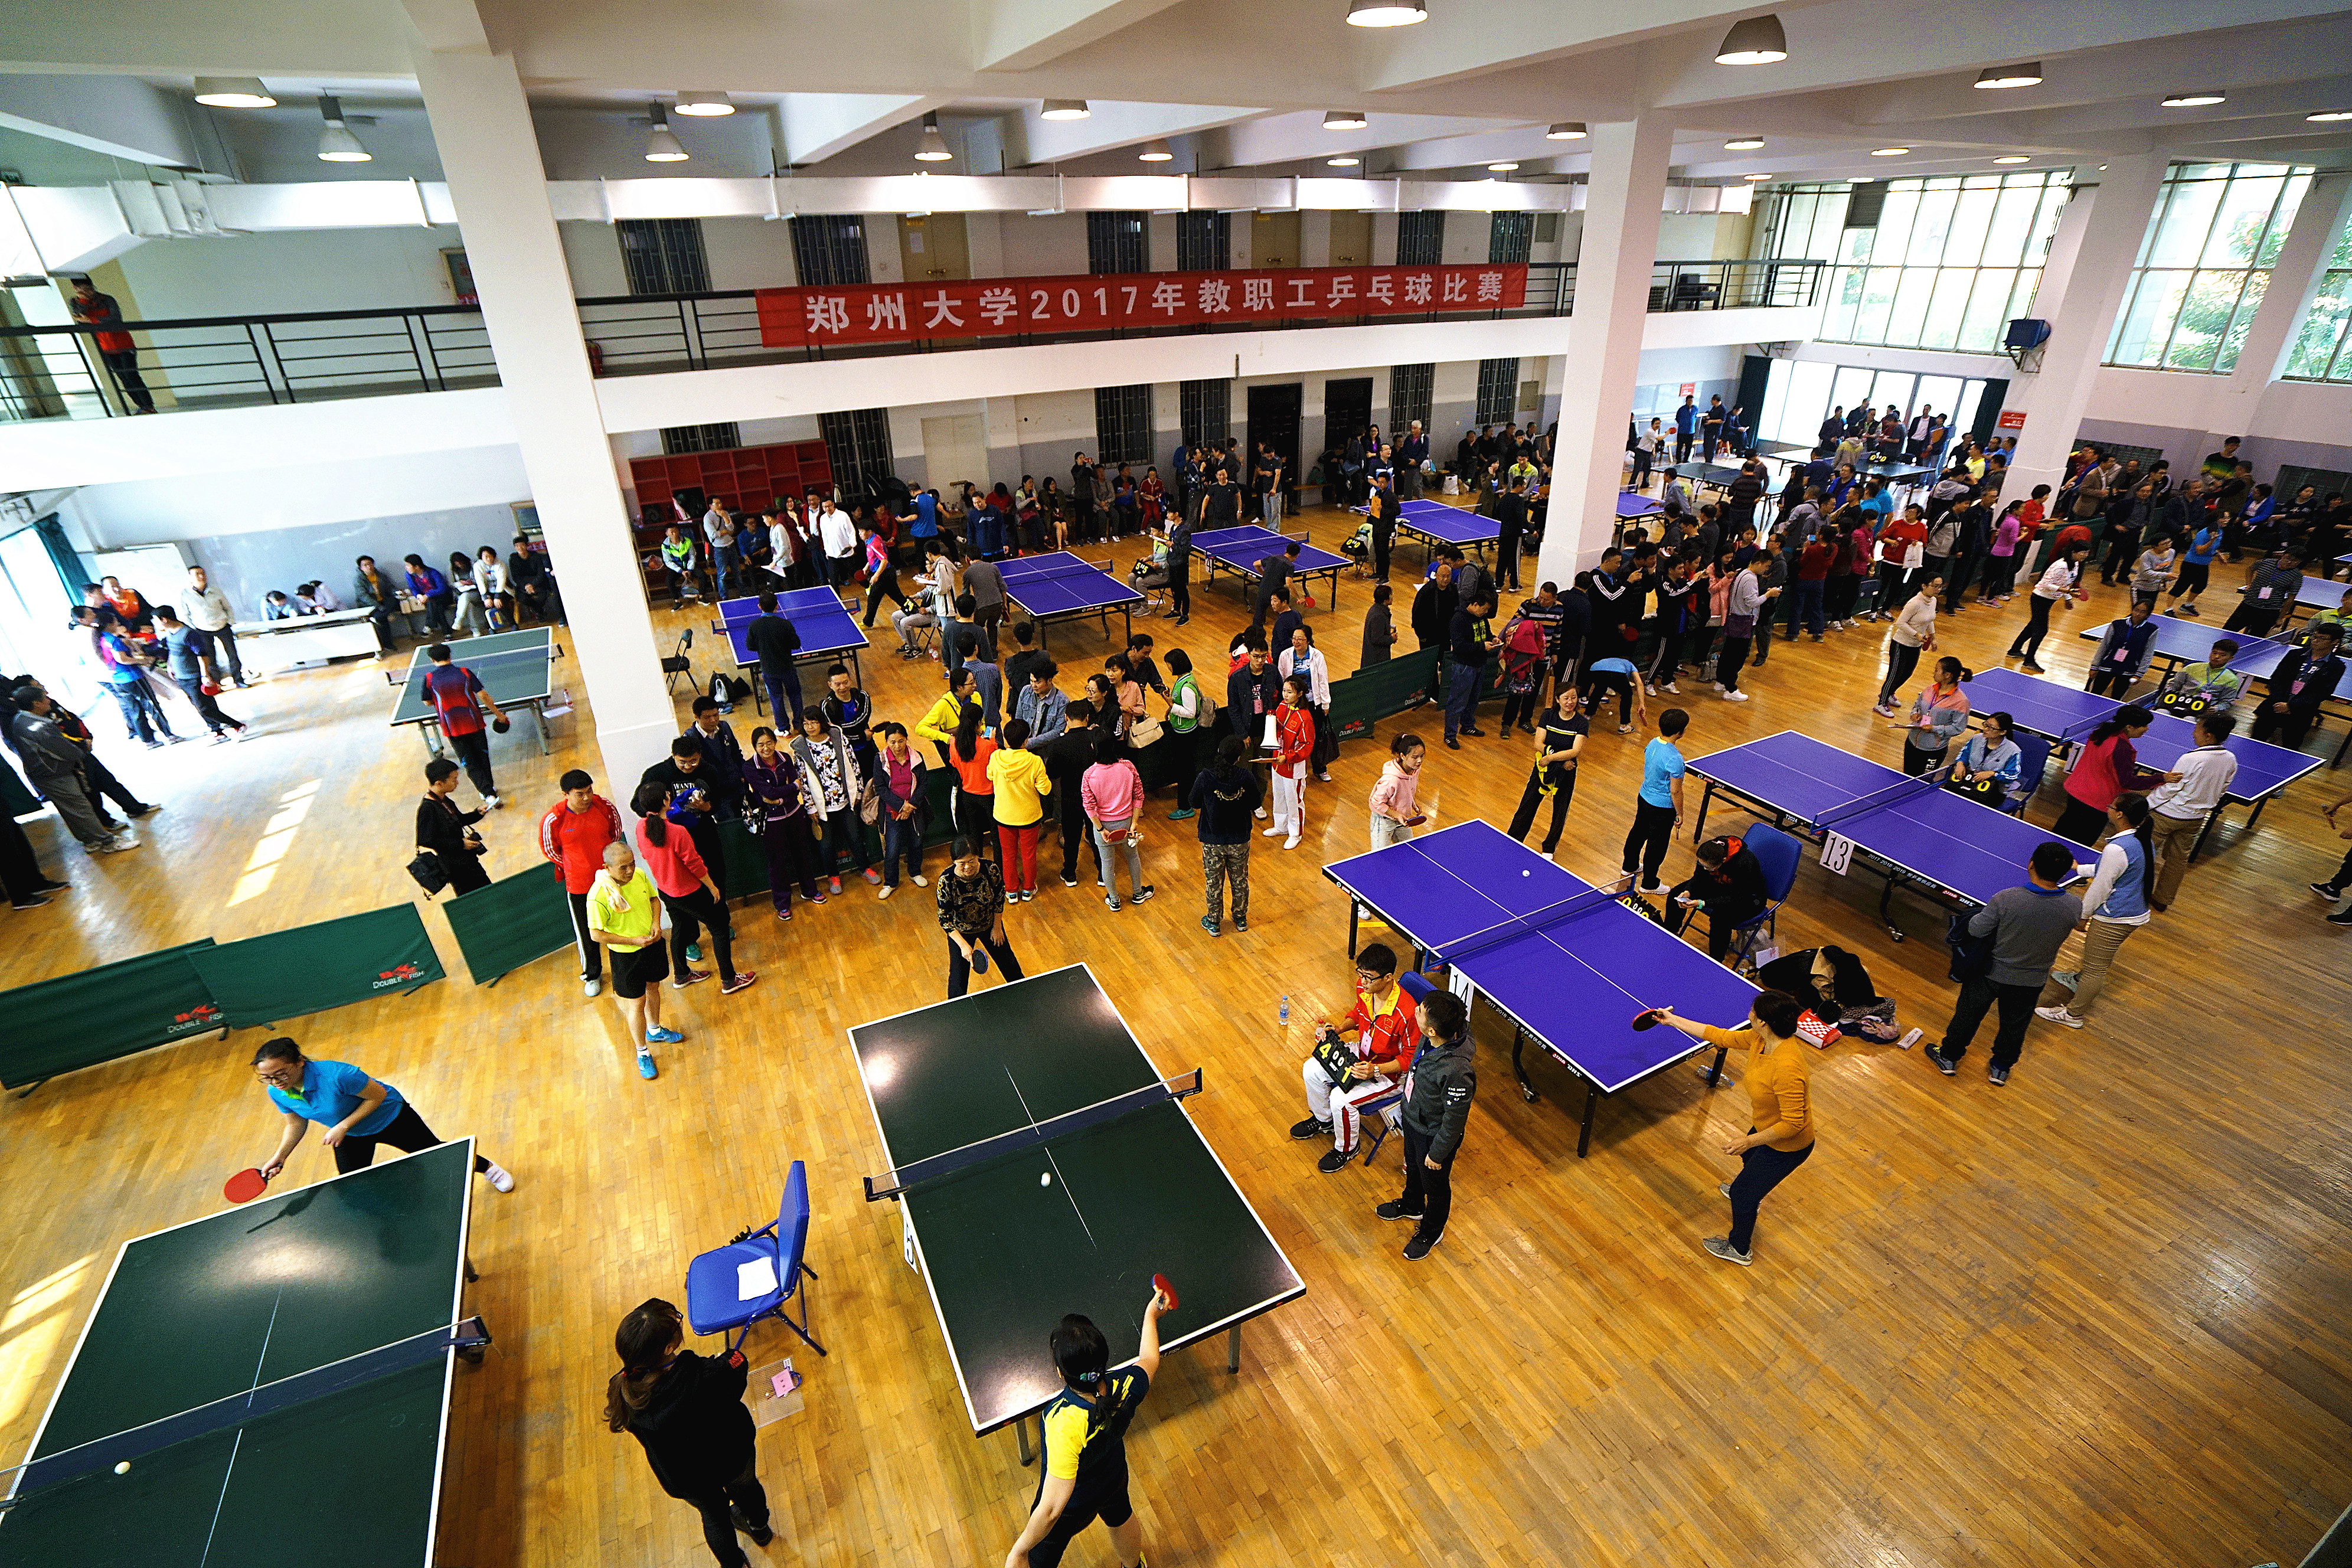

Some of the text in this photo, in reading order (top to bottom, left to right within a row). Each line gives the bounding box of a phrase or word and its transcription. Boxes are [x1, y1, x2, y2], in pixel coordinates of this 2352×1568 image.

[806, 271, 1503, 334] 郑州大学2017年教职工乒乓球比赛
[2164, 694, 2177, 704] 0
[2191, 701, 2204, 711] 0
[1977, 780, 1991, 792] 0
[1822, 836, 1849, 871] 13
[373, 971, 424, 989] DOUBLE FISH
[167, 1018, 201, 1034] DOUBLE
[1319, 1043, 1332, 1060] 4
[1341, 1066, 1351, 1083] 1
